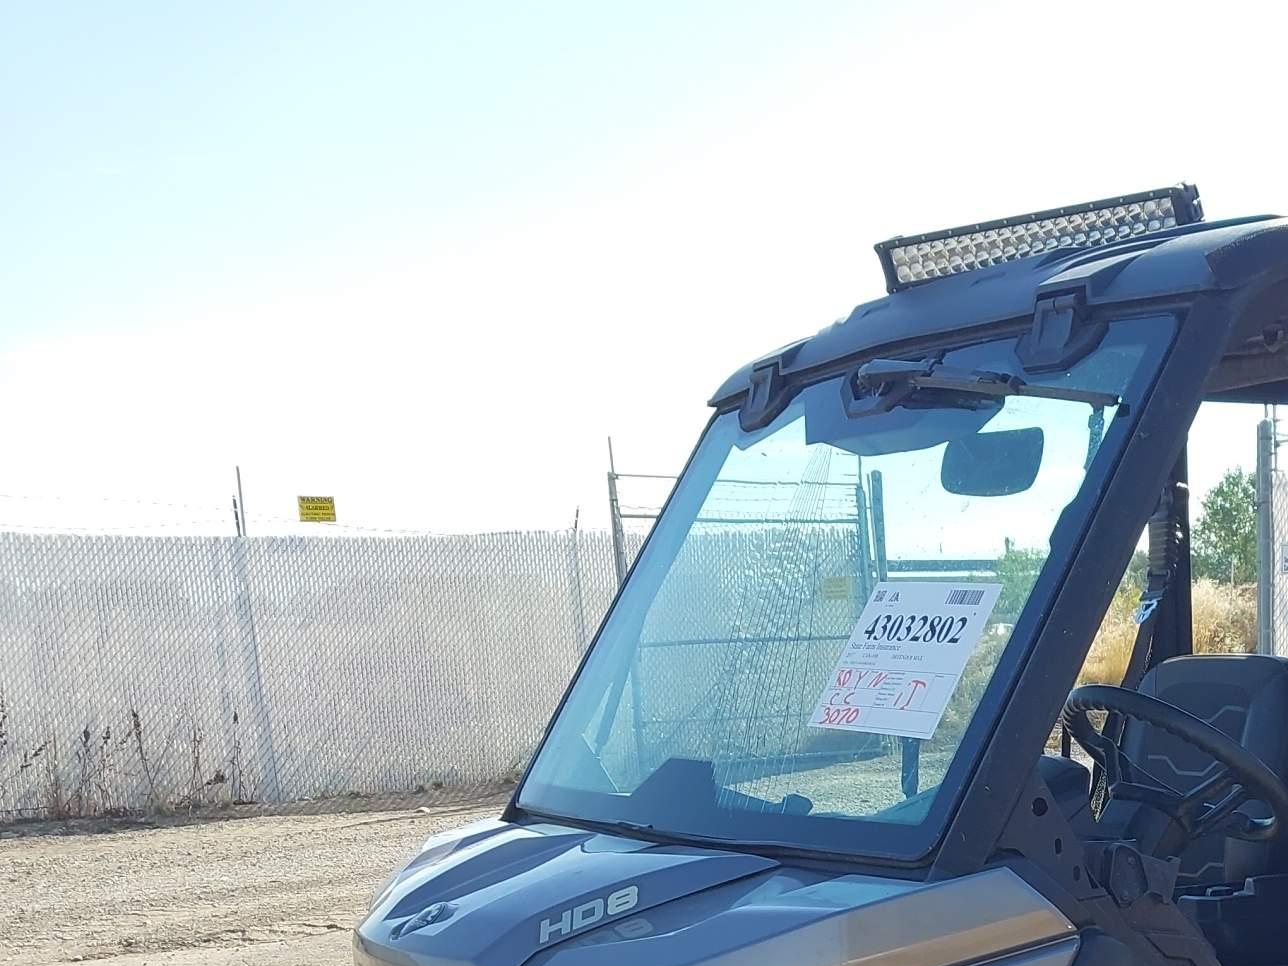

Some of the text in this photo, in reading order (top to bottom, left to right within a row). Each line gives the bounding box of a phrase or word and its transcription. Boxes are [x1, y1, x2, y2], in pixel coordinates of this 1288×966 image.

[864, 614, 968, 644] 43032802
[875, 643, 902, 651] Insurance
[818, 707, 860, 725] 3070
[539, 885, 638, 944] HD8
